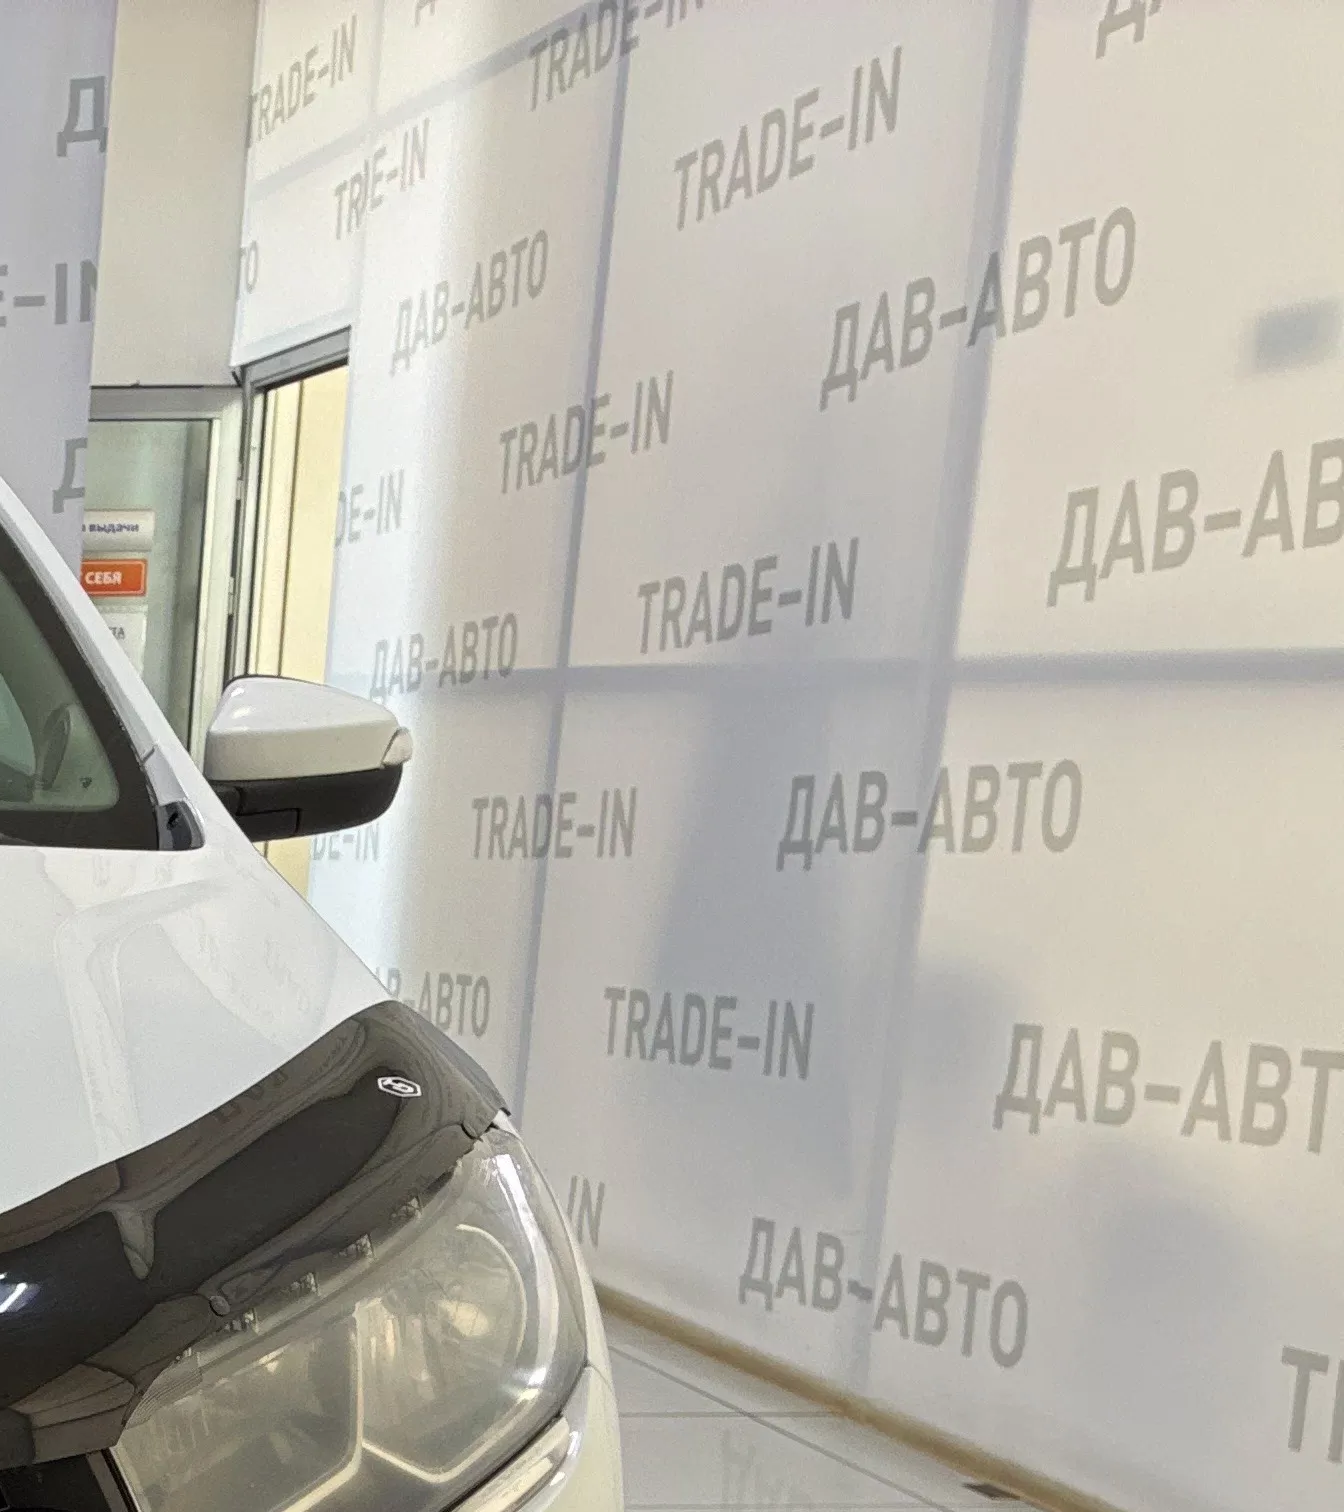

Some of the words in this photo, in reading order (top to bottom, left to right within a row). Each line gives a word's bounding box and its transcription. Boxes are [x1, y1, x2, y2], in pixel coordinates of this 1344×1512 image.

[675, 46, 902, 231] TRADE-IN
[390, 230, 549, 377] ДАВ-АВТО
[819, 207, 1137, 410] ДАВ-АВТО
[499, 371, 674, 494] TRADE-IN
[638, 538, 859, 654] TRADE-IN
[369, 612, 518, 704] ДАВ-АВТО
[471, 787, 638, 860] TRADE-IN
[777, 760, 1082, 871] ДАВ-АВТО
[604, 986, 815, 1081] TRADE-IN
[739, 1218, 1029, 1368] ДАВ-АВТО
